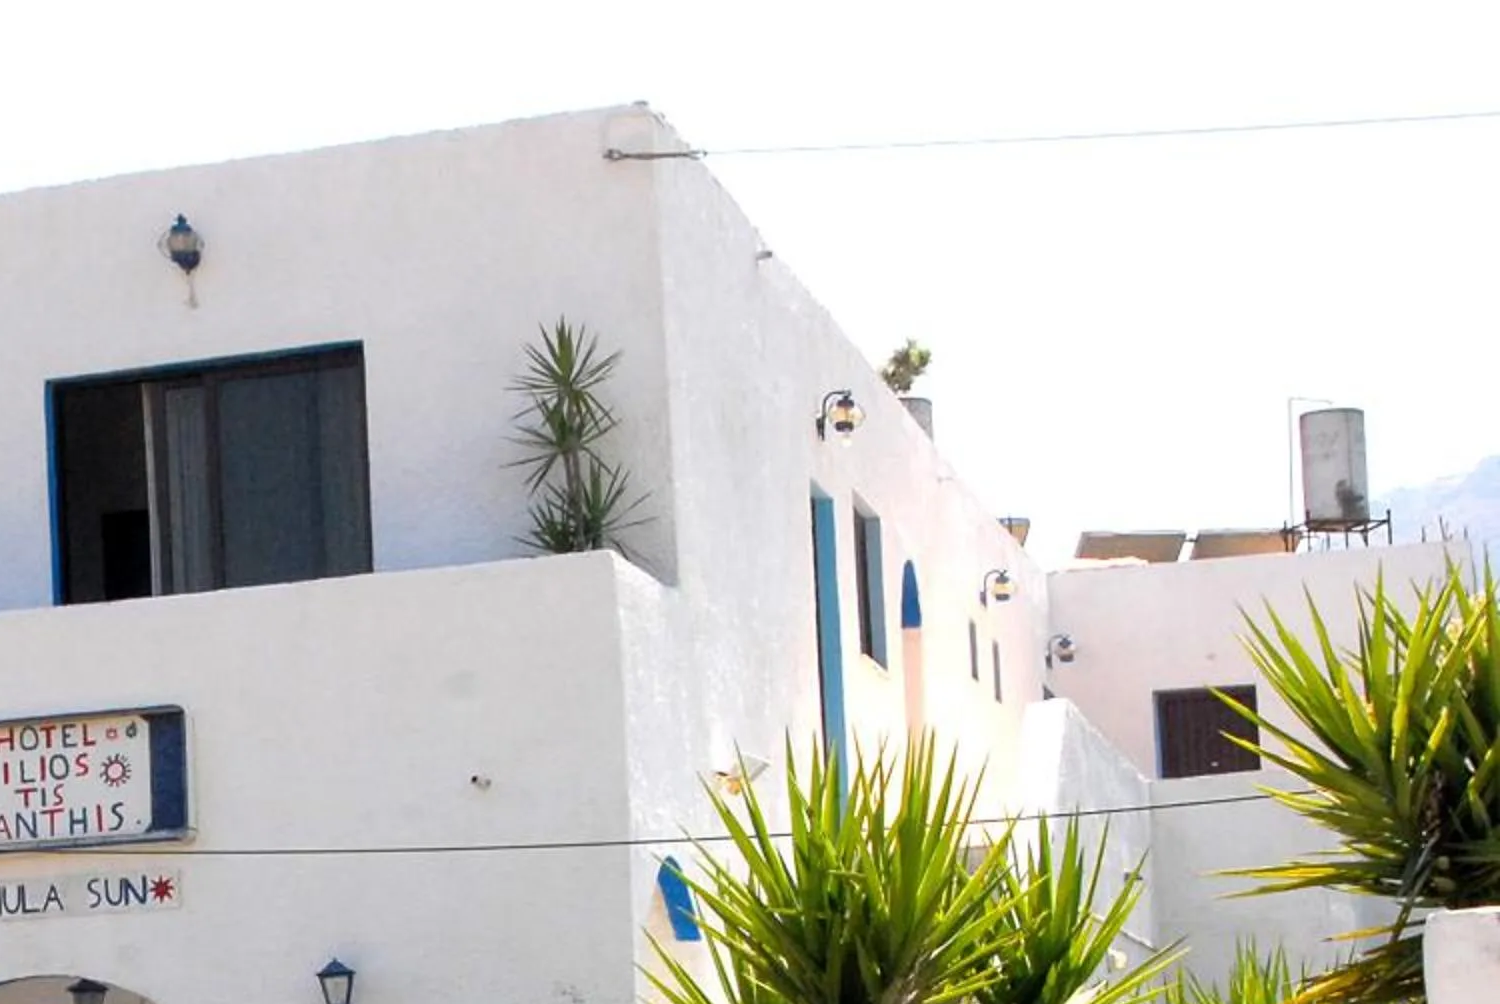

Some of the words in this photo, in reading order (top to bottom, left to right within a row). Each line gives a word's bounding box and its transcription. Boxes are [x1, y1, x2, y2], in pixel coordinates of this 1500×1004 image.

[3, 753, 89, 786] ILIOS
[14, 785, 65, 809] TIS
[87, 875, 148, 909] SUN
